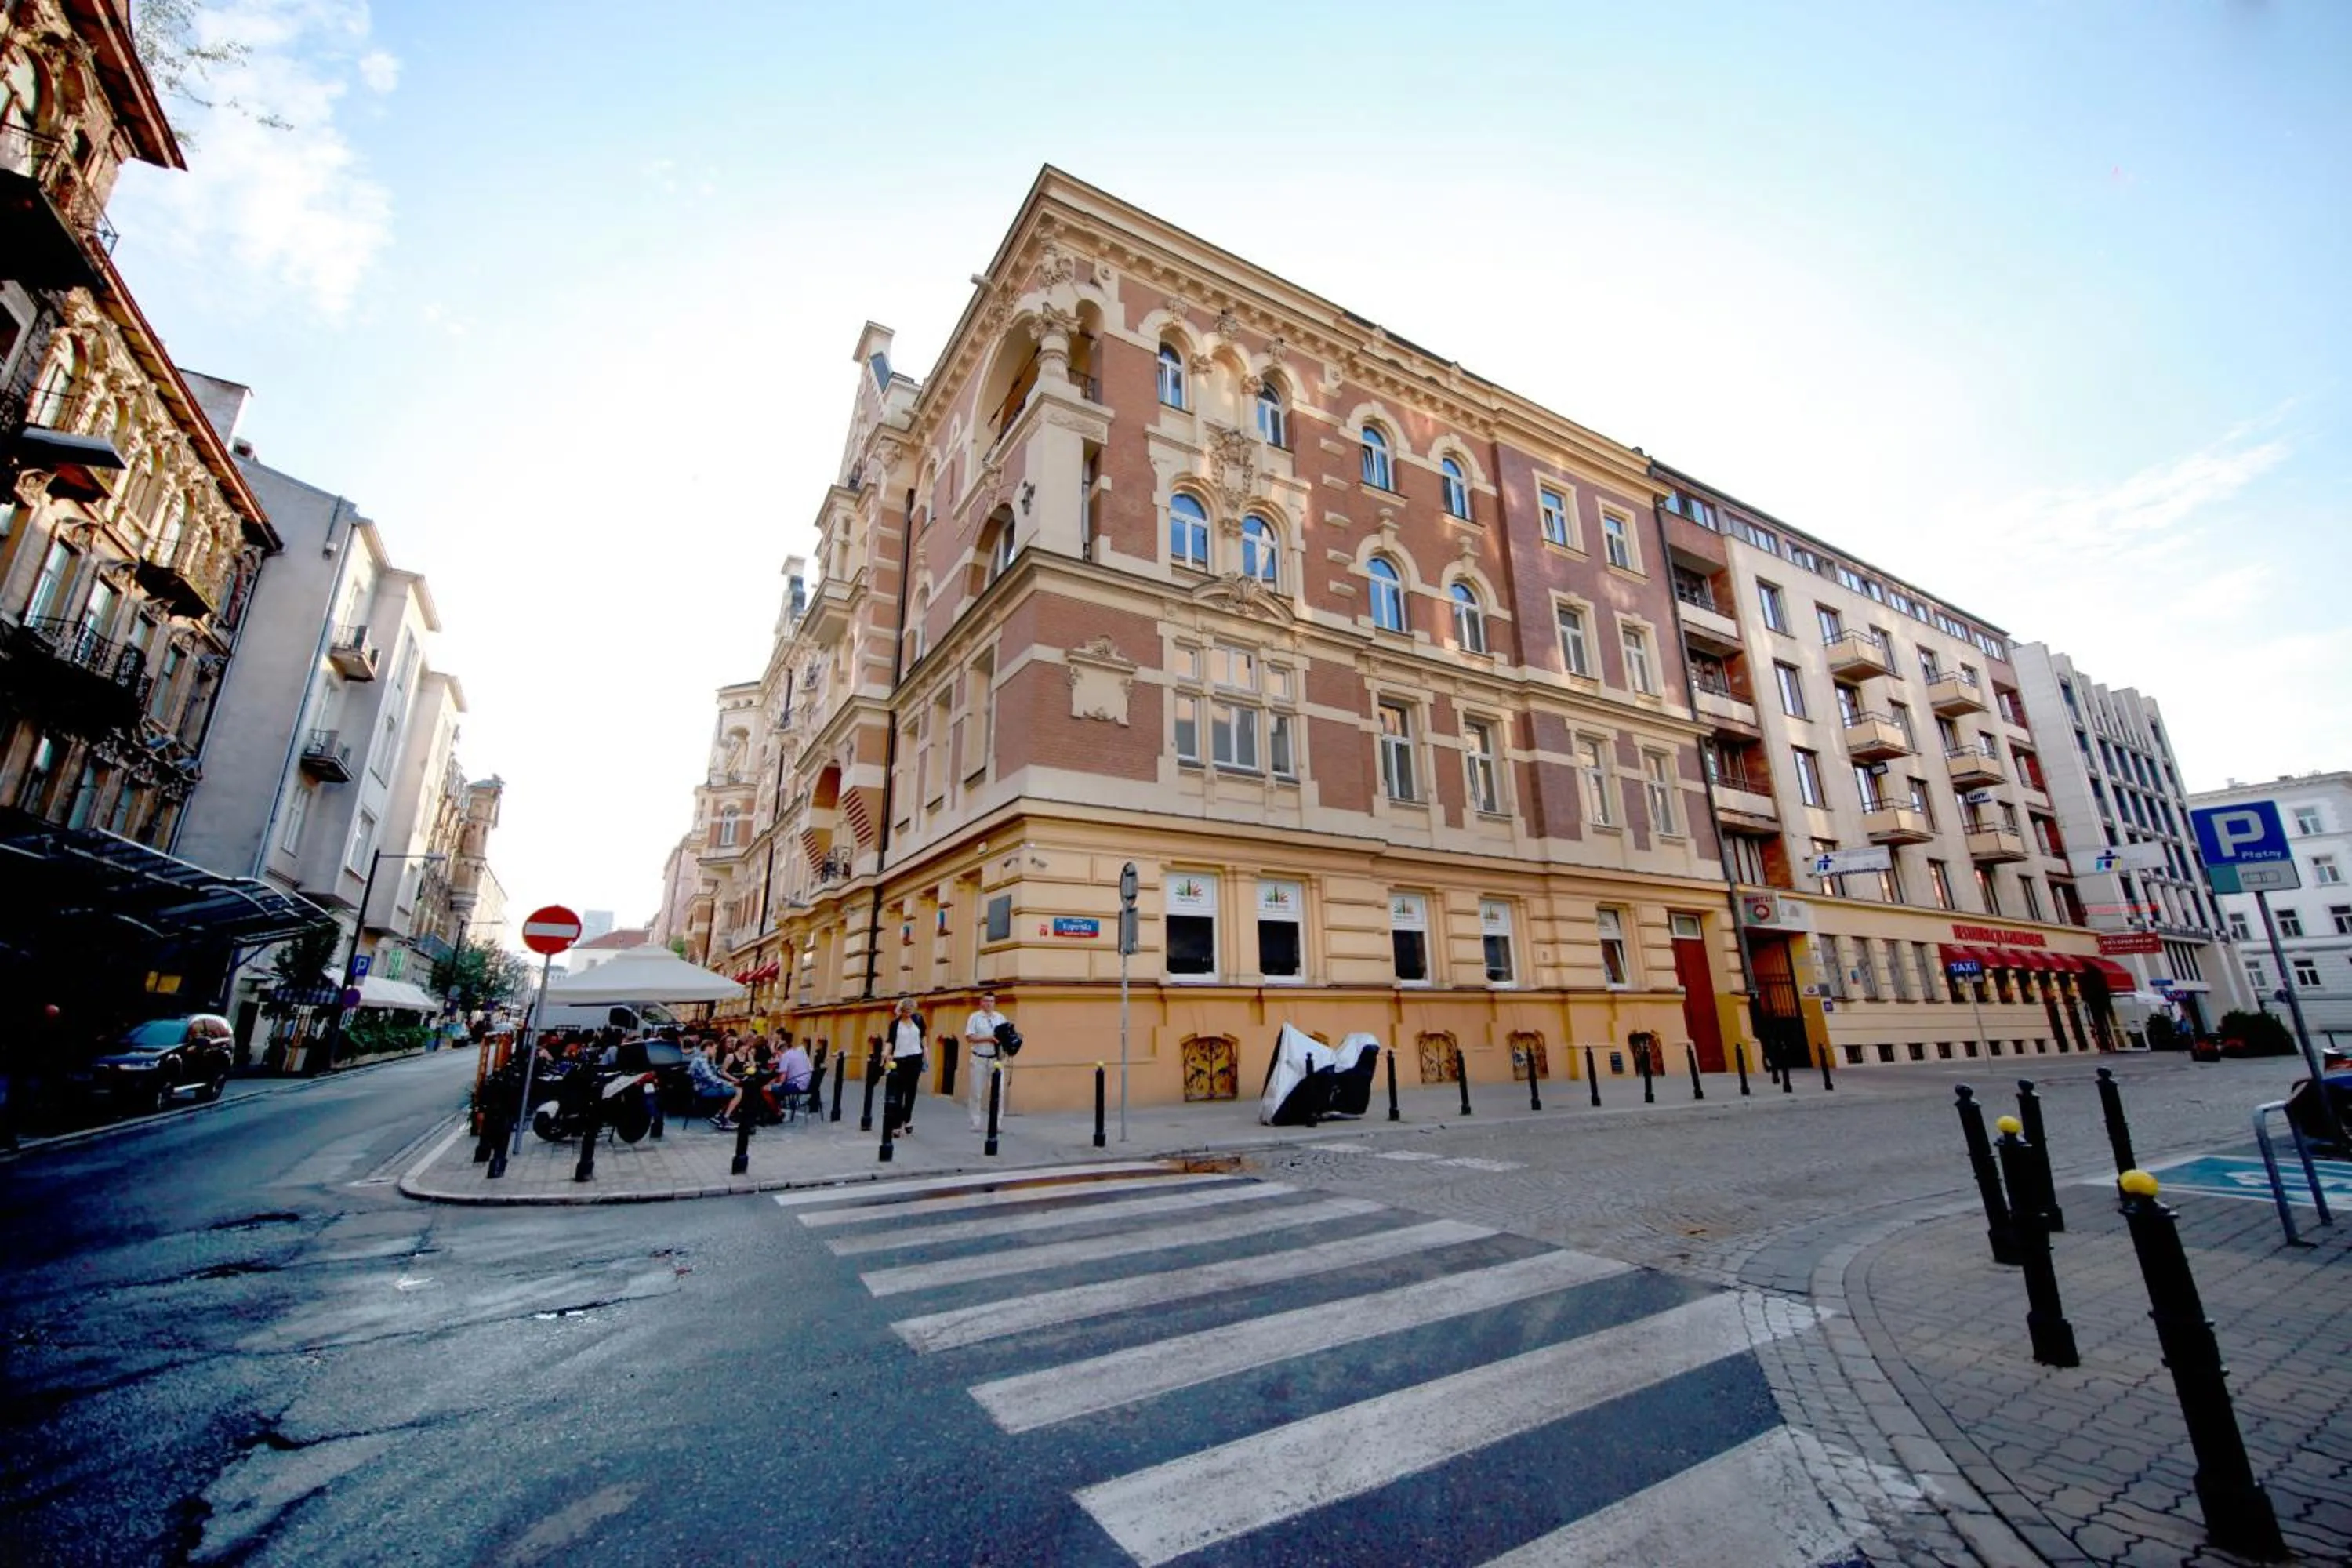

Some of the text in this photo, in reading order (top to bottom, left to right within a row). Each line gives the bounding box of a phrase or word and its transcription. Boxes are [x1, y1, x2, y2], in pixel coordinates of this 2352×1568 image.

[2211, 810, 2265, 858] P
[355, 957, 368, 973] P
[1951, 961, 1977, 973] TAXI
